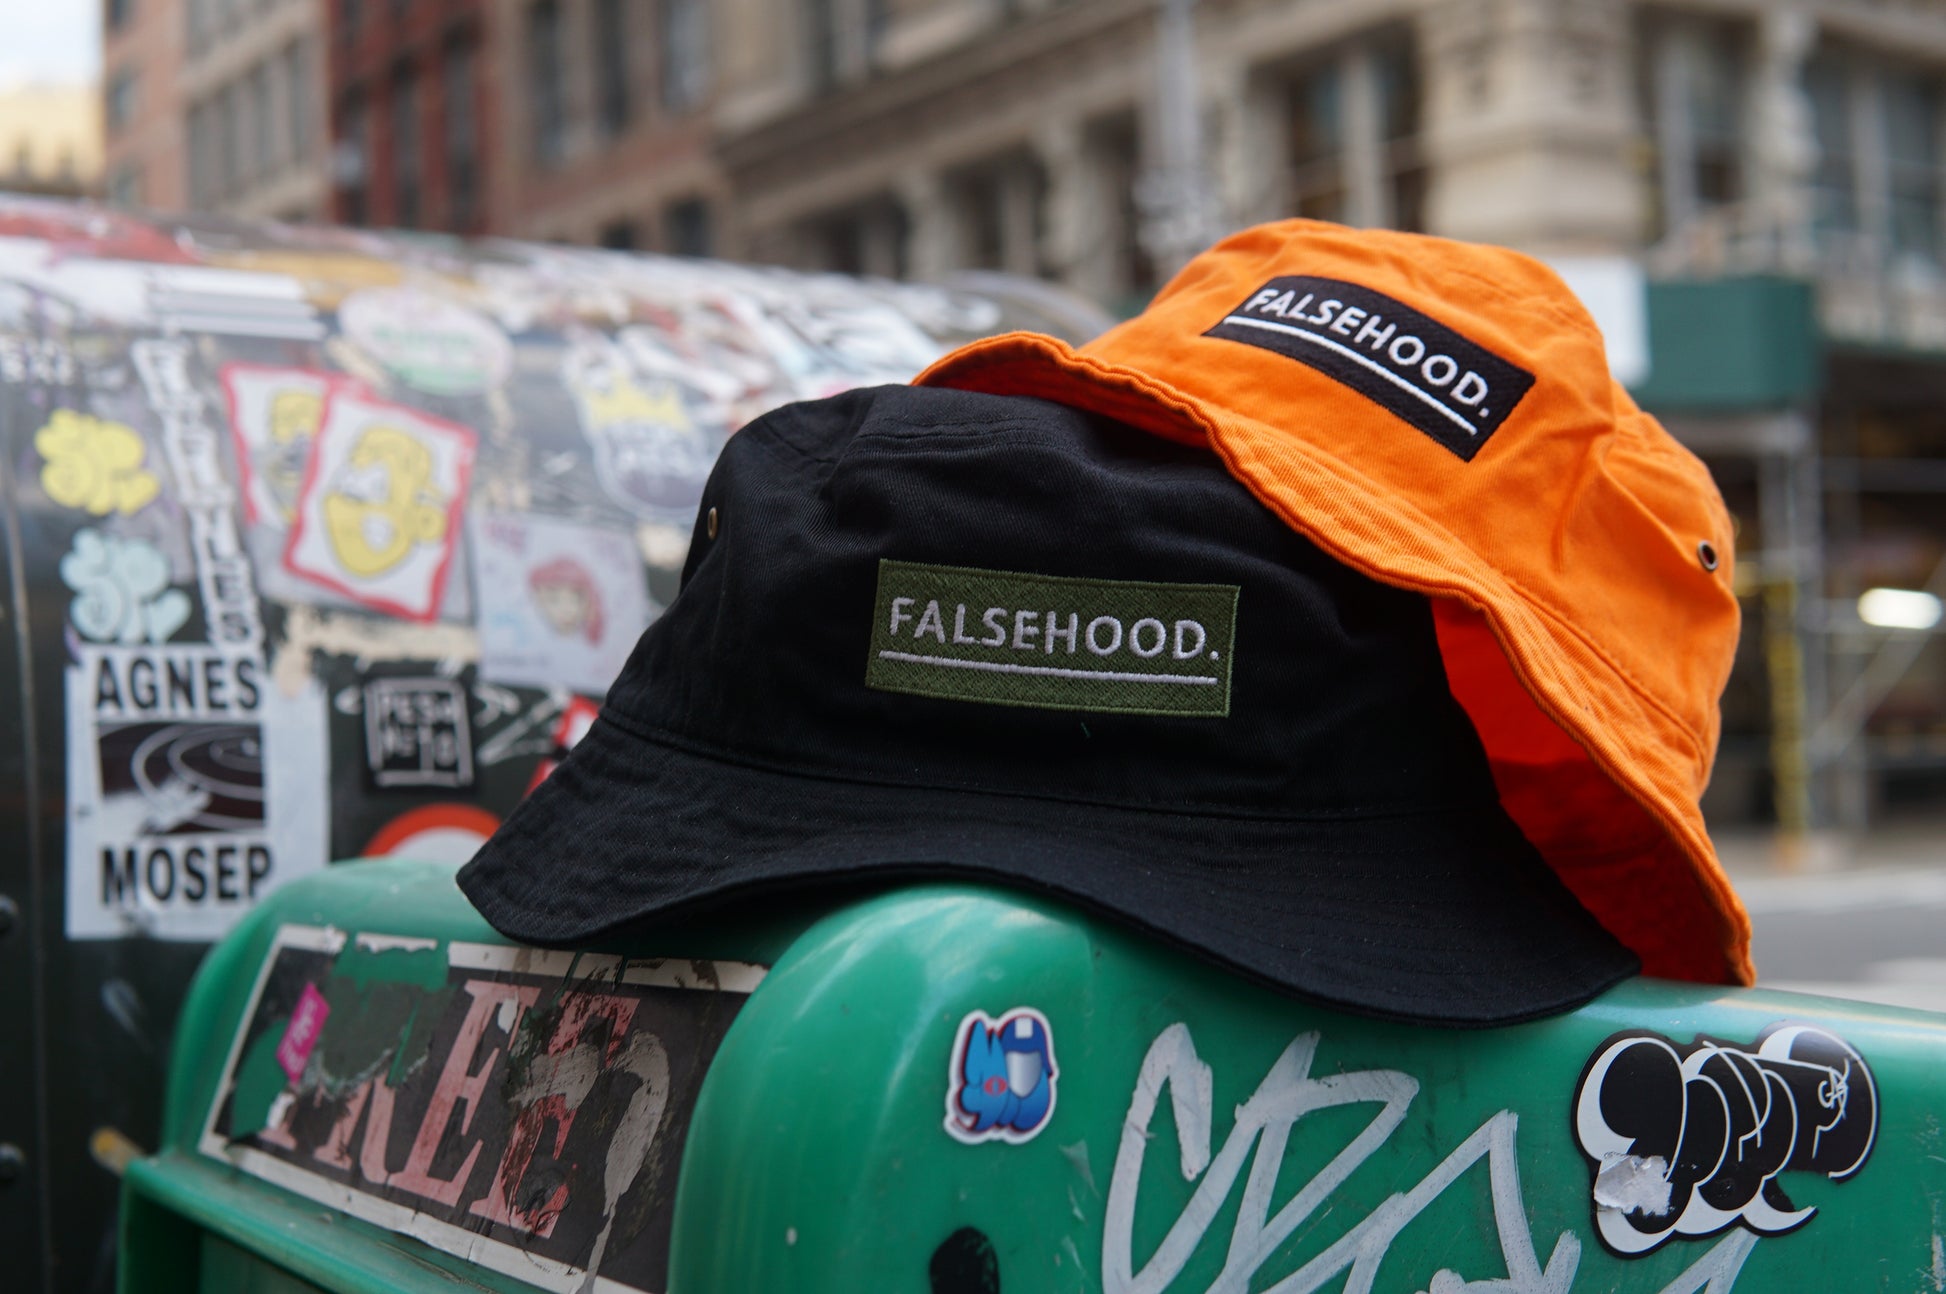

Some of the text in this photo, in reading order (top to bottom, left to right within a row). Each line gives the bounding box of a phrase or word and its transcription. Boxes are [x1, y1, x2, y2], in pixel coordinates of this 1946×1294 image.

[1245, 288, 1490, 418] FALSEHOOD.
[889, 597, 1219, 660] FALSEHOOD.
[97, 656, 260, 711] AGNES
